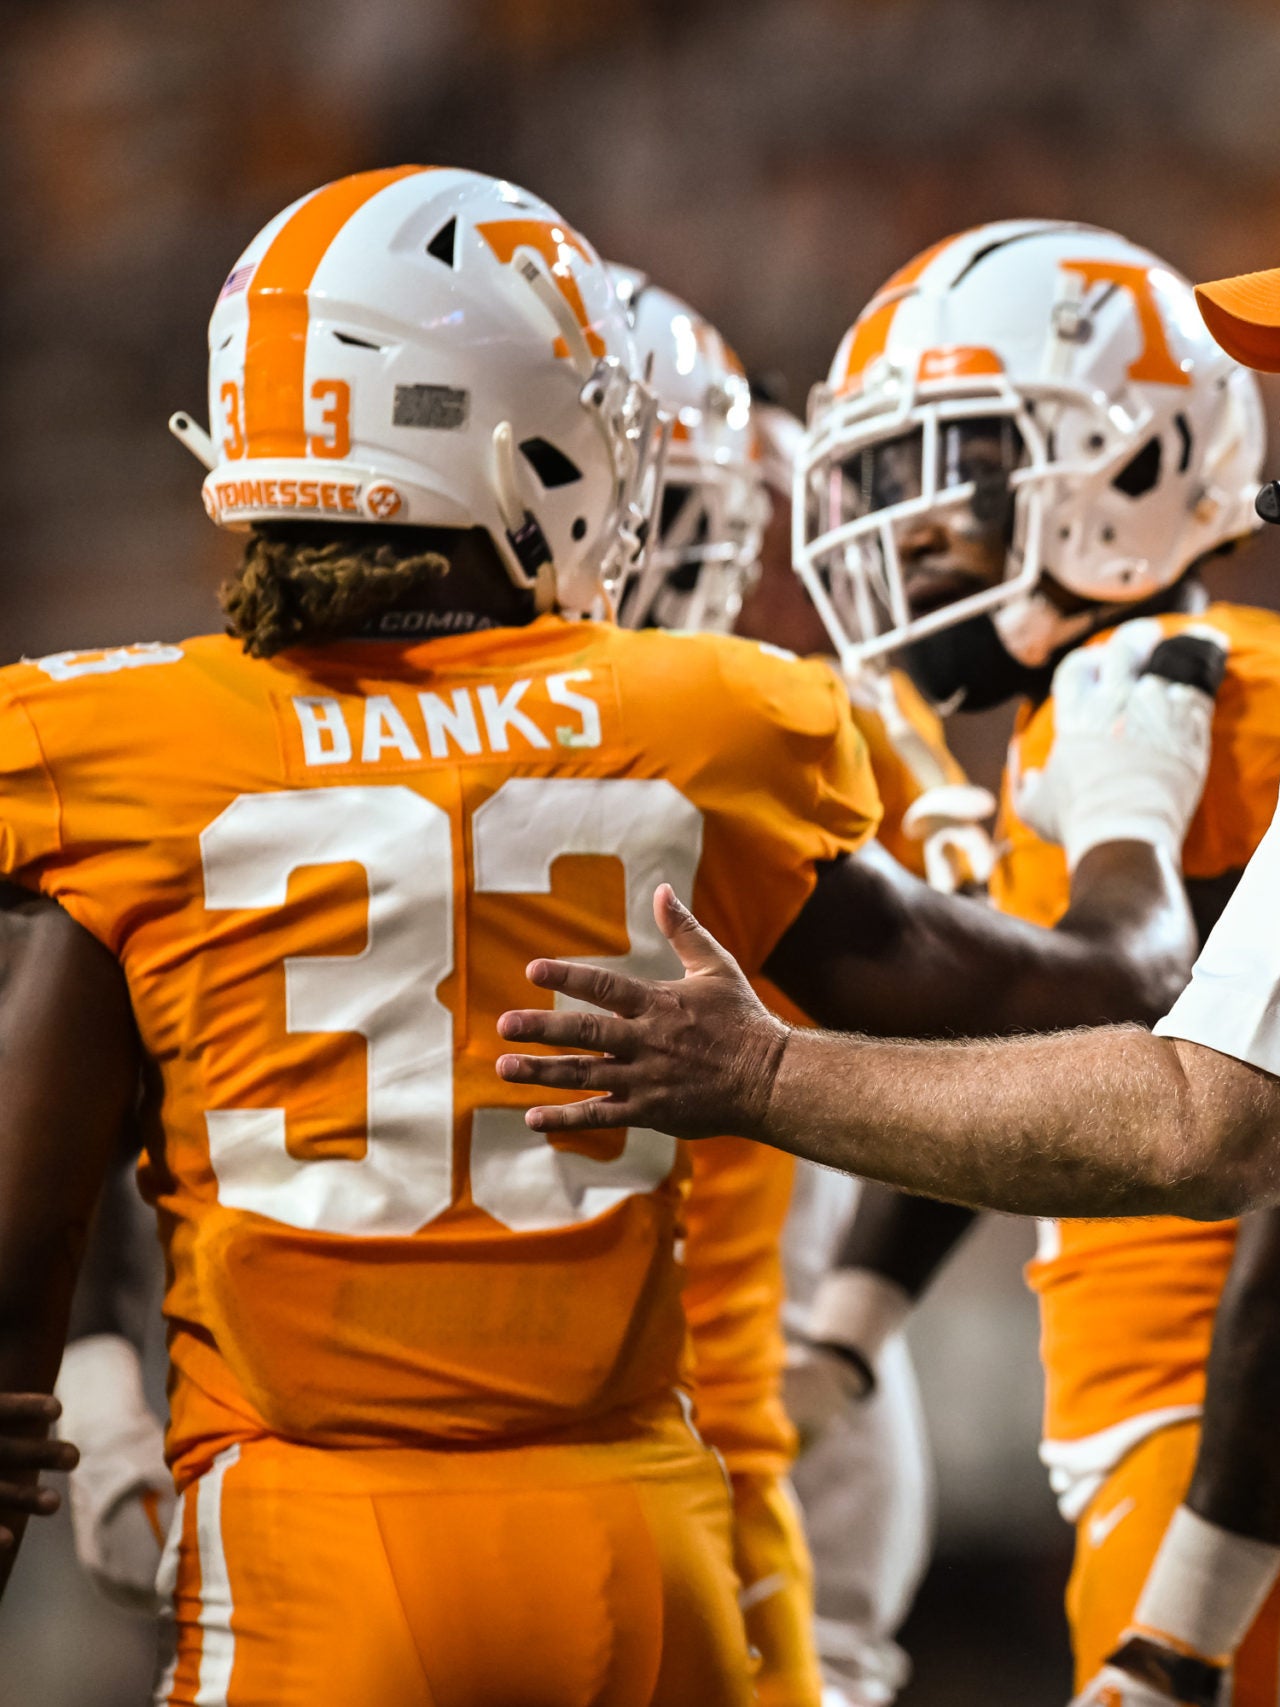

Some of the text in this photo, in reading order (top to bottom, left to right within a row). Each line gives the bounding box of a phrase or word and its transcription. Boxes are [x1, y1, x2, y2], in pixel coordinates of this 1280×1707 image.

[215, 479, 358, 511] TENNESSEE
[292, 669, 602, 767] BANKS
[199, 777, 703, 1237] 33
